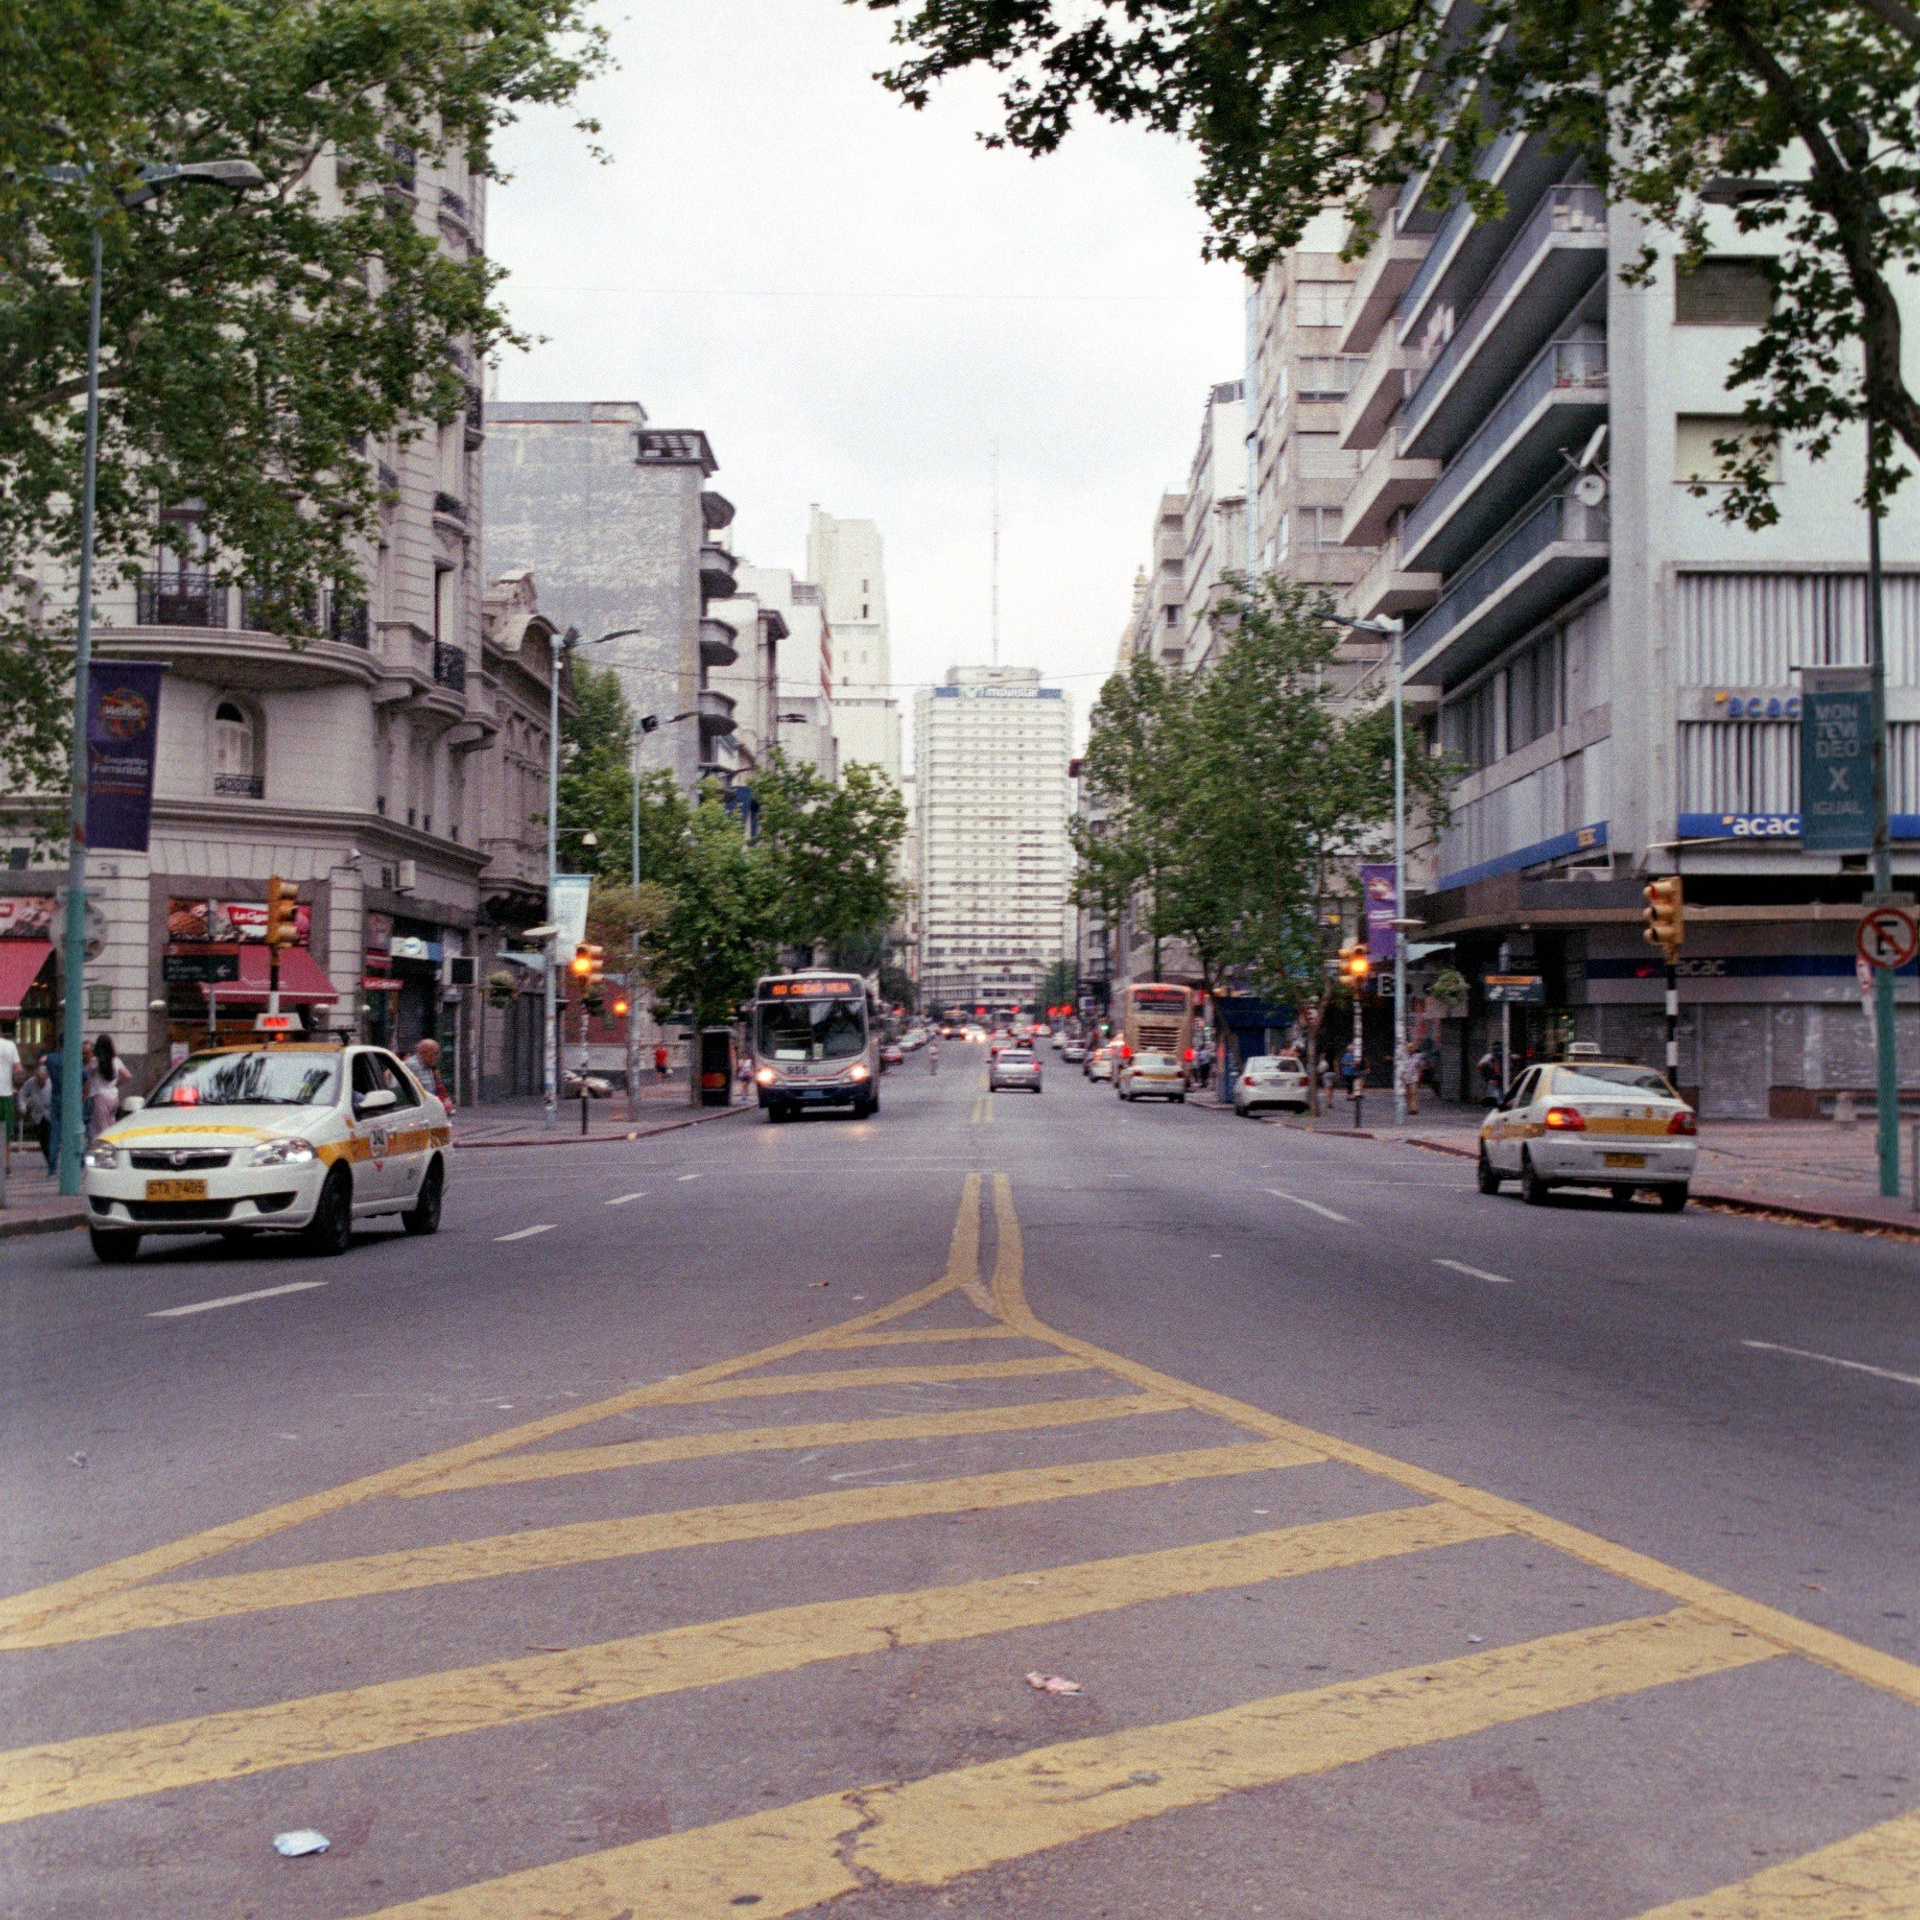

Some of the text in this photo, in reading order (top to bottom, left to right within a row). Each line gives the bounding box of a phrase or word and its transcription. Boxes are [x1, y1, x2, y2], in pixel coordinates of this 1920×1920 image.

[1728, 698, 1800, 717] acac
[1815, 740, 1860, 758] DEO
[1828, 767, 1849, 791] X
[1733, 817, 1800, 836] acac
[1675, 959, 1726, 976] acac
